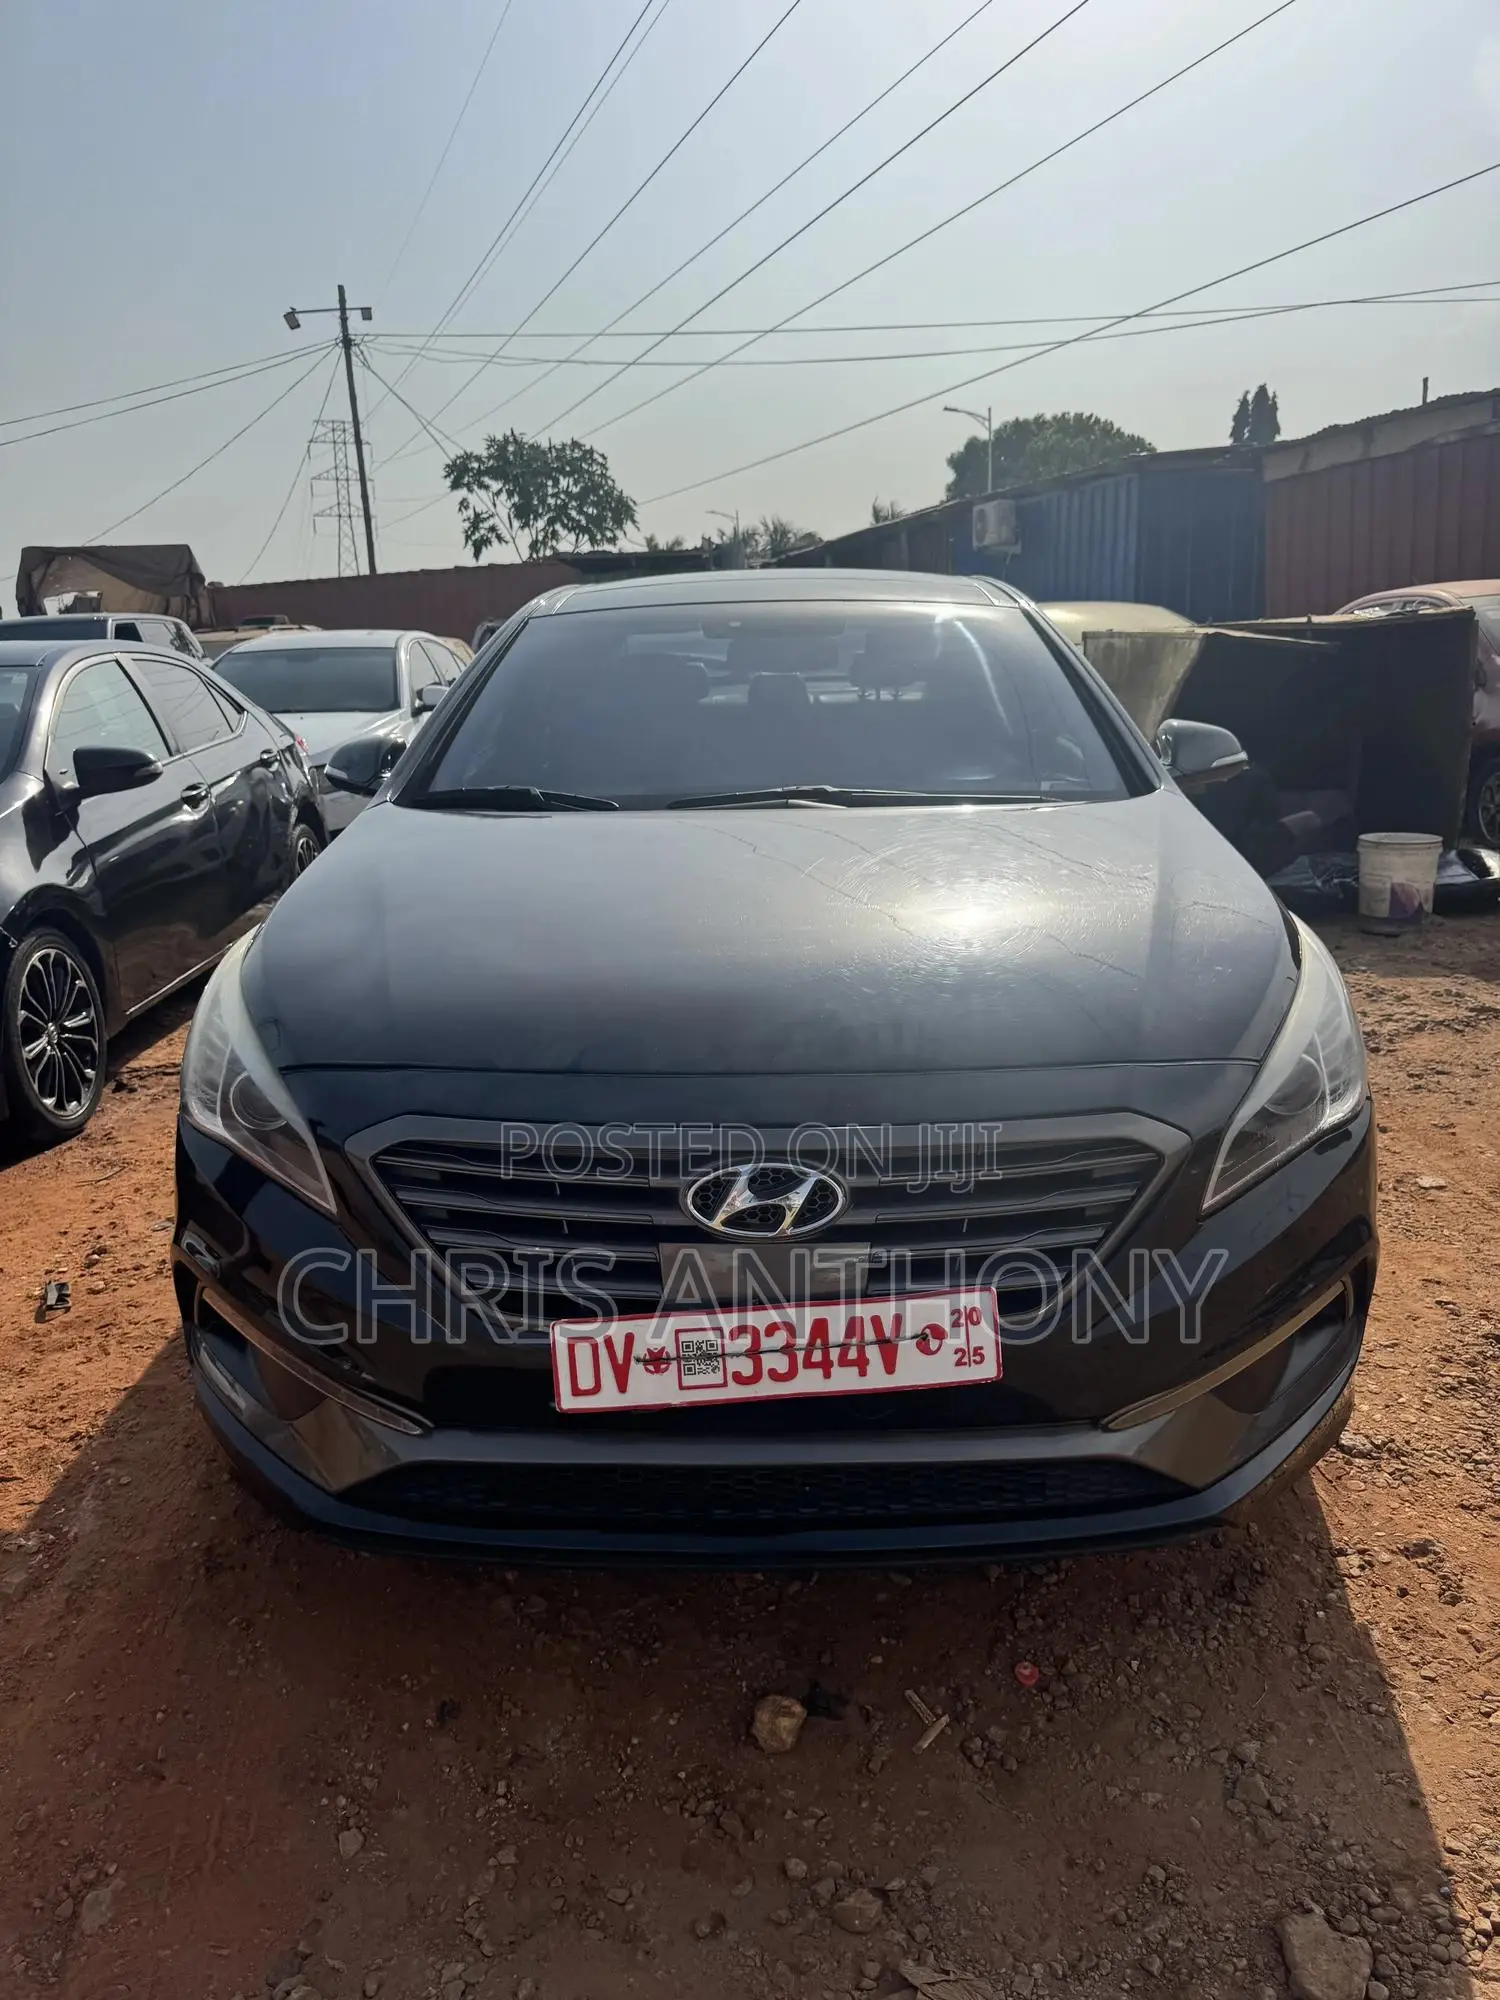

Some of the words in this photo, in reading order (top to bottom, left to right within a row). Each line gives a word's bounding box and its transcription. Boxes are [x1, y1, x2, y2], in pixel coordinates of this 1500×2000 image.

[950, 1306, 982, 1328] 20
[569, 1332, 635, 1396] DV
[728, 1313, 904, 1386] 3344V
[954, 1346, 985, 1368] 25
